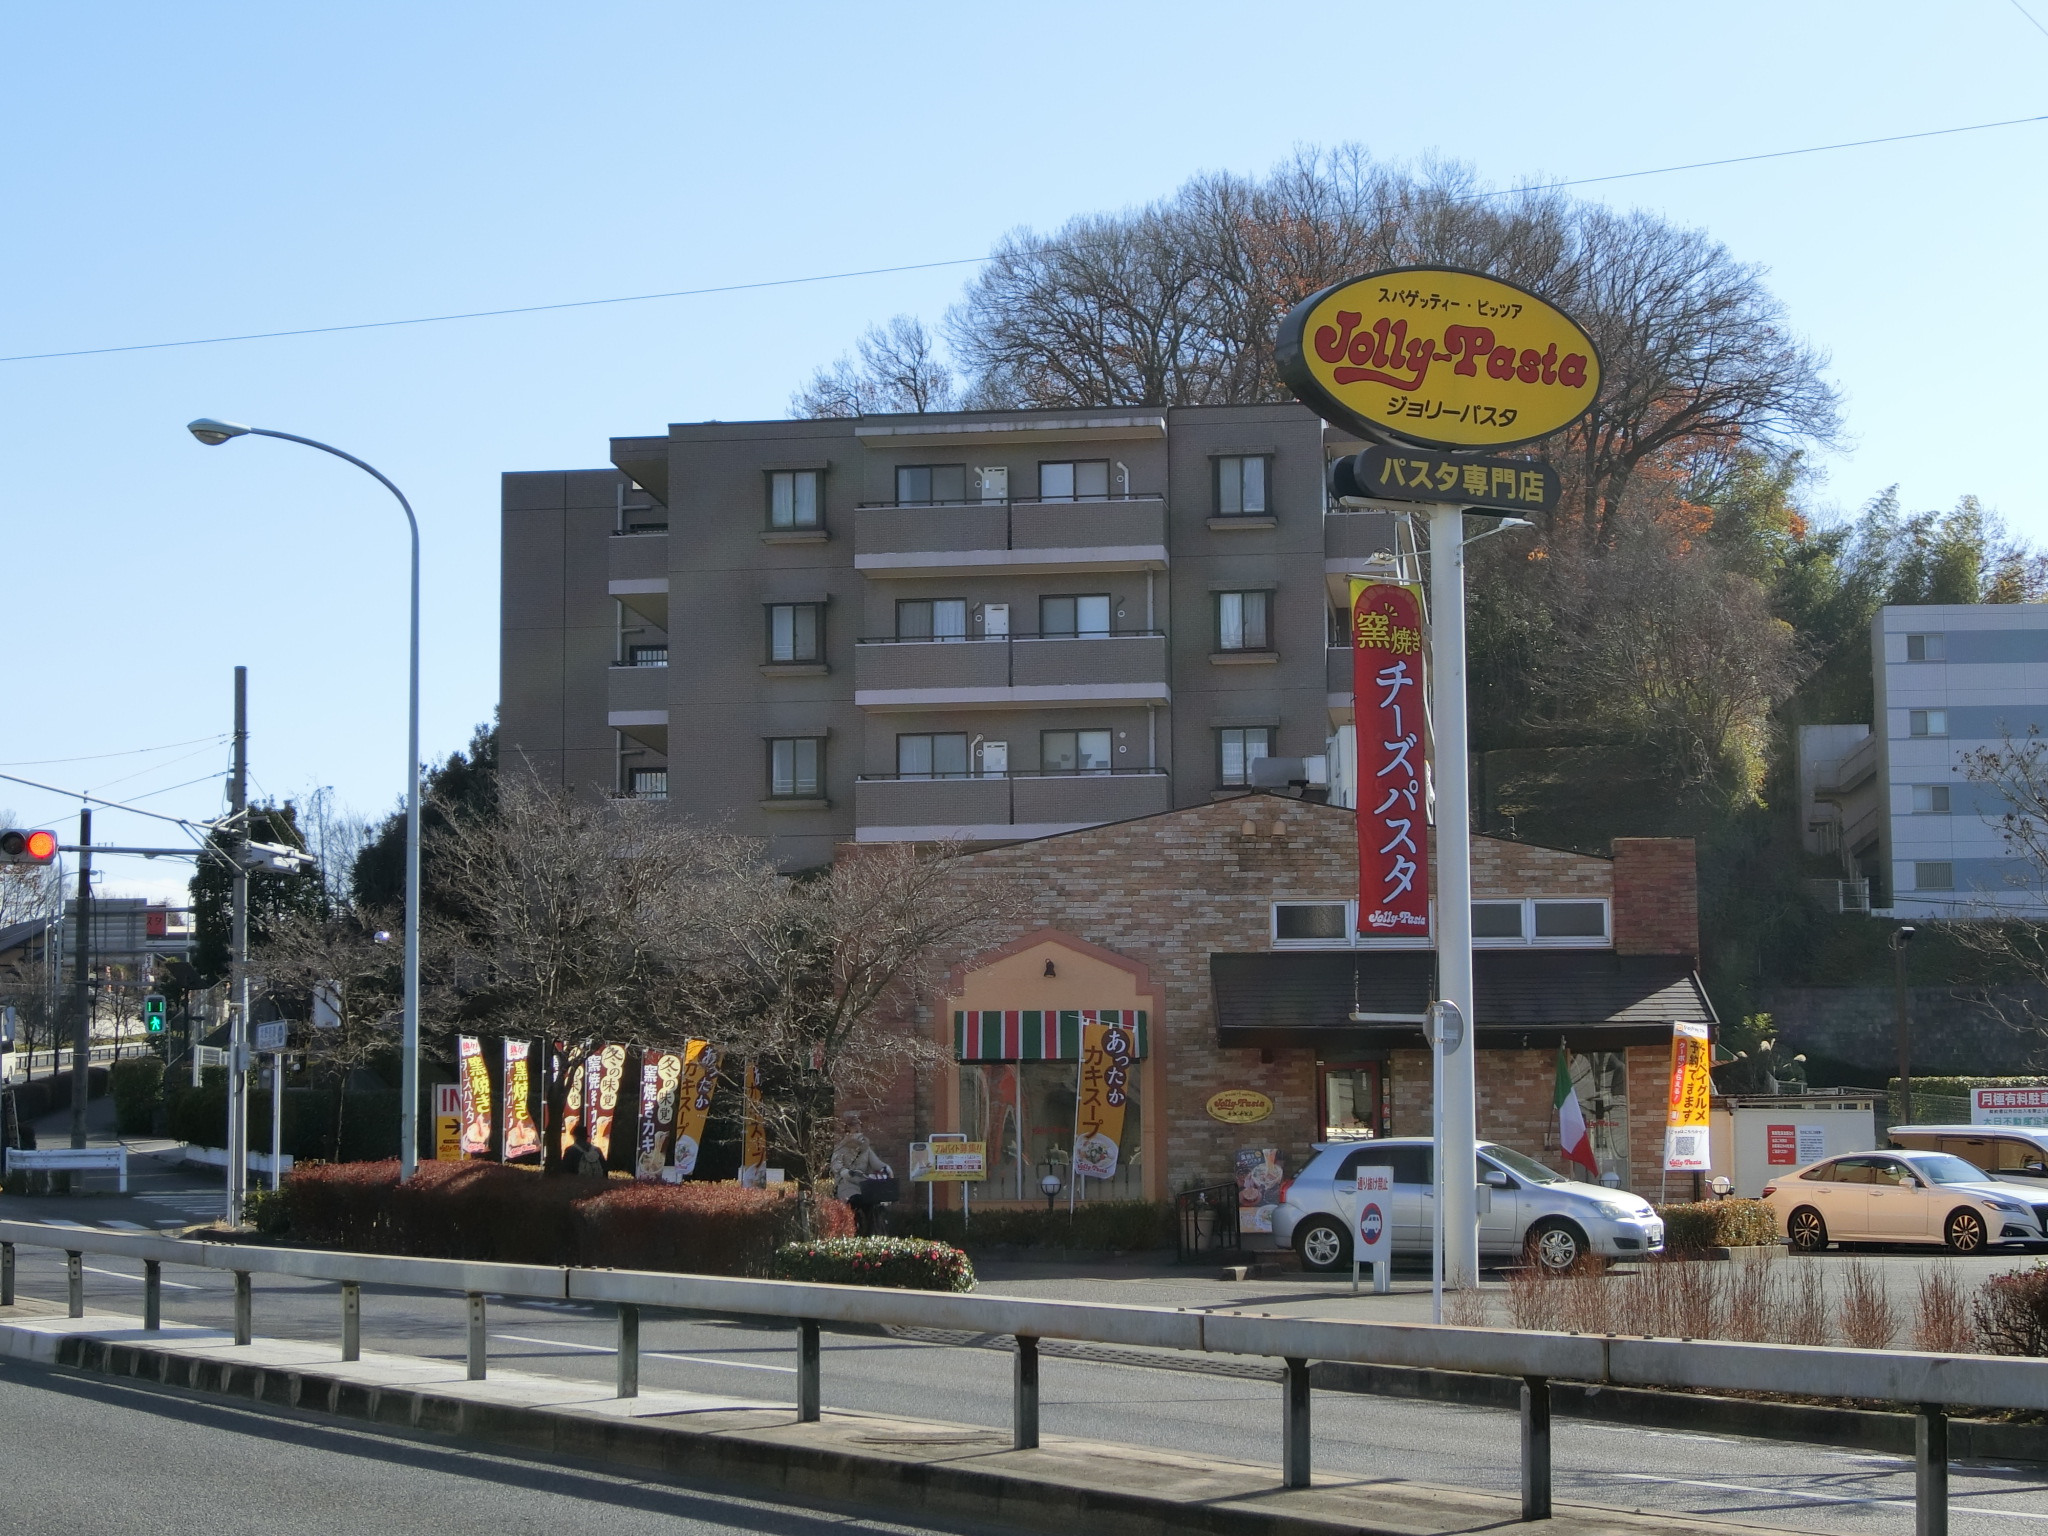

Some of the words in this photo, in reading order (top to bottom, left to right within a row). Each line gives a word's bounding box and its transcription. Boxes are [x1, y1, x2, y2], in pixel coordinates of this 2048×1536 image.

[1314, 310, 1588, 392] Jolly-Pasta
[1386, 396, 1518, 428] ジョリーパスタ
[1379, 457, 1545, 503] パスタ専門店
[1357, 612, 1421, 656] 窯焼き
[1373, 660, 1419, 905] チーズパスタ
[1368, 909, 1426, 927] Jolly-Pasta
[468, 1056, 491, 1114] 窯焼き
[603, 1046, 624, 1107] 冬の味覚
[659, 1056, 679, 1121] 冬の味覚
[1082, 1045, 1104, 1139] カキスープ
[1107, 1030, 1130, 1105] あったか
[641, 1065, 658, 1155] 窯焼きカキ
[676, 1062, 699, 1140] カキスープ
